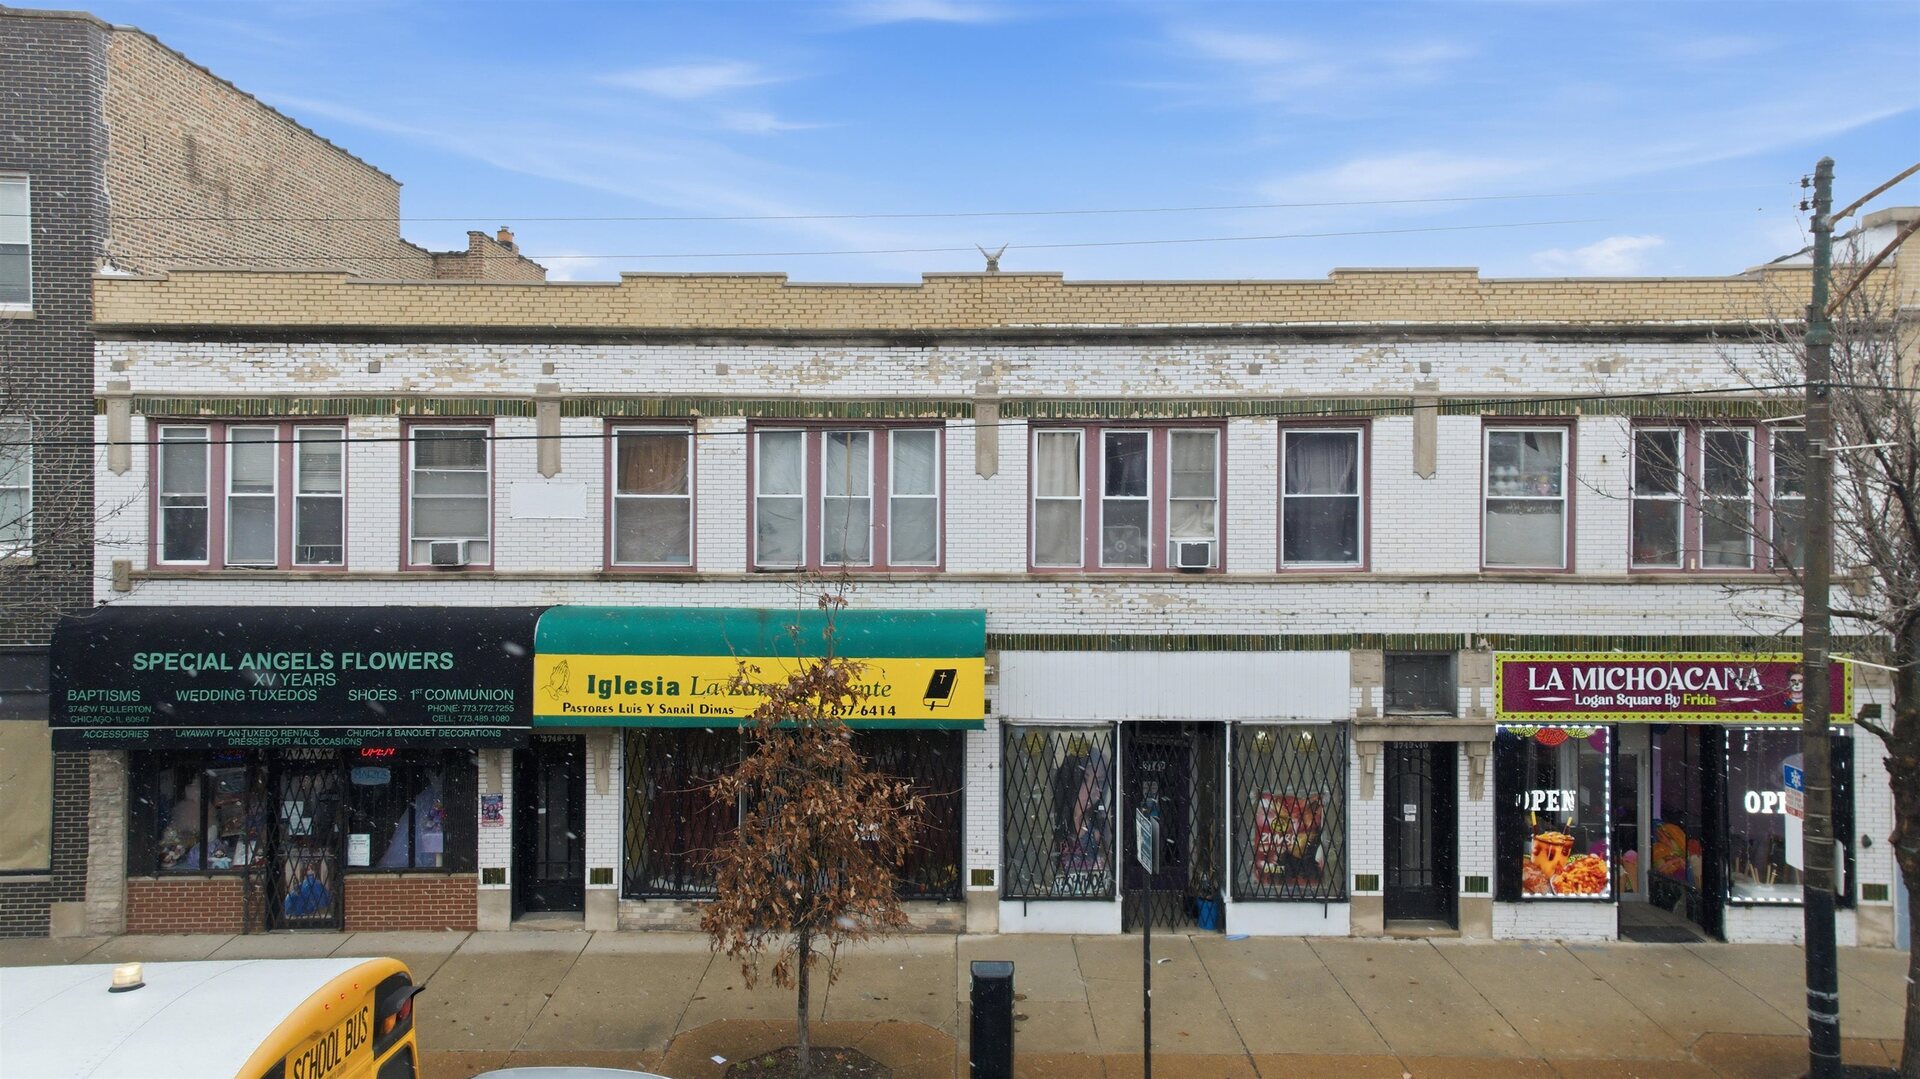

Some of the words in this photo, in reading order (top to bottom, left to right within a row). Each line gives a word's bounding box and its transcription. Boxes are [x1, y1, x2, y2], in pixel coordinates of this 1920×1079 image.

[133, 652, 233, 671] SPECIAL
[238, 652, 334, 670] ANGELS
[342, 652, 454, 670] FLOWERS
[253, 673, 277, 686] XV
[280, 673, 337, 687] YEARS
[1528, 667, 1566, 691] LA
[1572, 667, 1764, 691] MICHOACANA
[587, 675, 680, 699] Iglesia
[690, 676, 719, 696] La
[67, 689, 141, 701] BAPTISMS
[176, 689, 245, 701] WEDDING
[249, 689, 318, 701] TUXEDOS
[348, 689, 398, 701] SHOES
[424, 689, 515, 701] COMMUNION
[1575, 693, 1614, 707] Logan
[1616, 693, 1662, 707] Square
[1665, 693, 1681, 707] By
[1683, 693, 1717, 705] Frida
[100, 705, 152, 713] FULLERTON
[427, 704, 461, 712] PHONE:
[462, 704, 515, 712] 773.772.7255
[647, 703, 655, 713] Y
[82, 730, 150, 738] ACCESSORIES
[175, 729, 215, 737] LAYAWAY
[281, 729, 320, 737] RENTALS
[346, 729, 384, 737] CHURCH
[386, 729, 393, 737] &
[394, 729, 436, 737] BANQUET
[438, 729, 502, 737] DECORATIONS
[228, 737, 270, 745] DRESSES
[309, 737, 363, 745] OCCASIONS
[293, 1027, 341, 1079] SCHOOL
[345, 1006, 368, 1057] BUS
